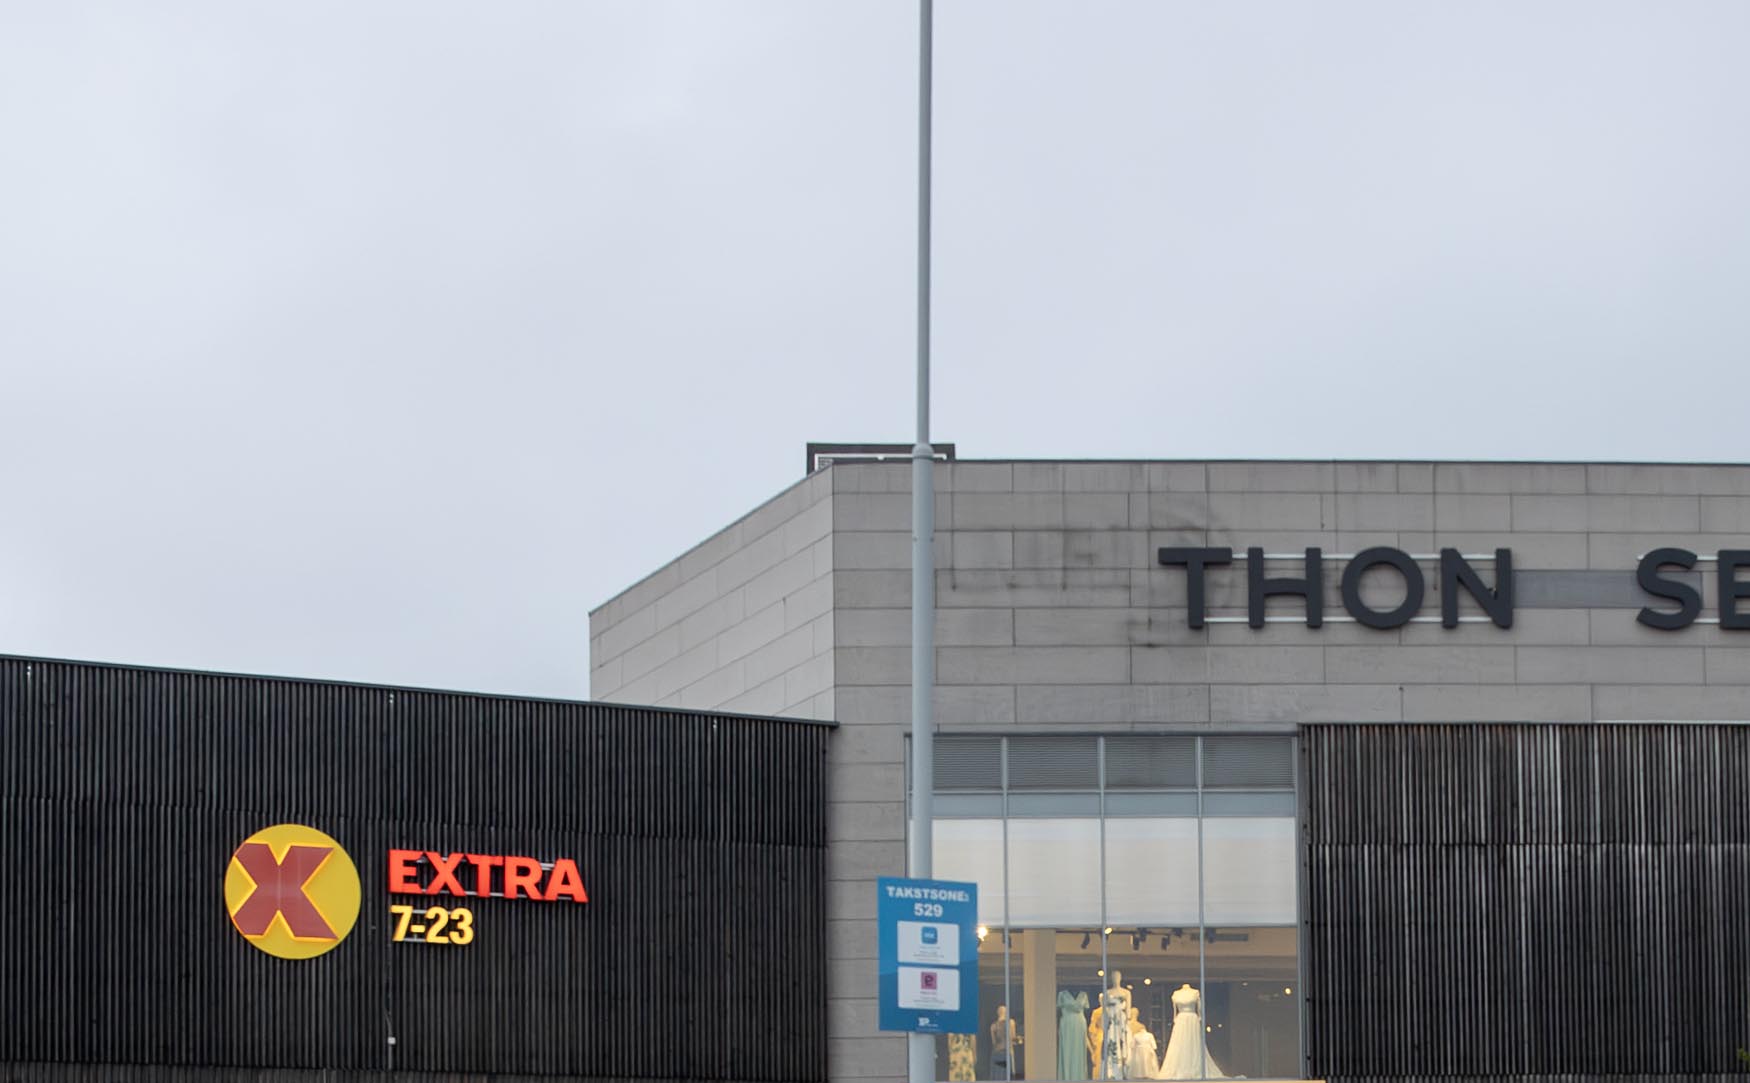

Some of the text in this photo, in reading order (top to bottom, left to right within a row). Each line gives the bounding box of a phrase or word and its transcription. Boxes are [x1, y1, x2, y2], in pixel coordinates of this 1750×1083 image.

[1157, 546, 1513, 630] THON
[388, 849, 589, 904] EXTRA
[886, 886, 970, 902] TAKSTSONE:
[390, 904, 475, 946] 7-23
[914, 902, 944, 918] 529
